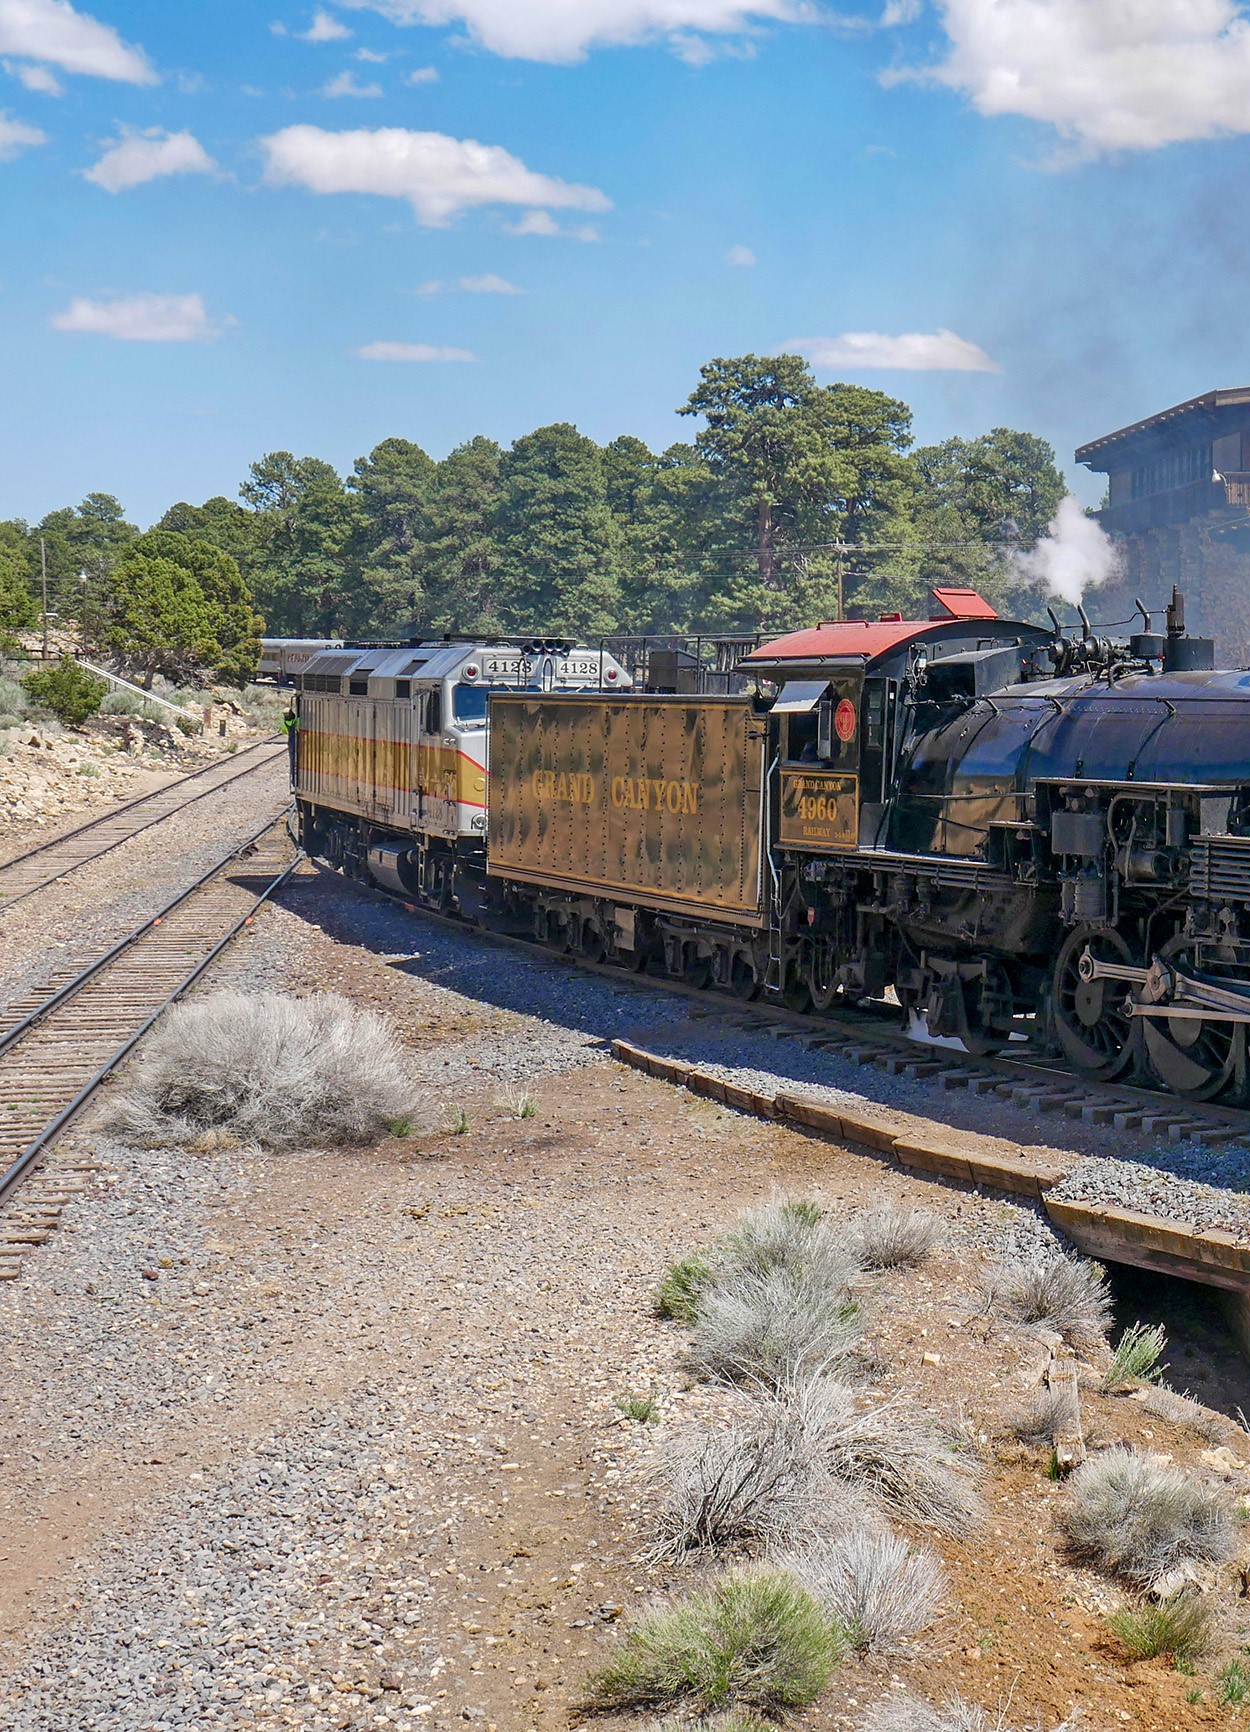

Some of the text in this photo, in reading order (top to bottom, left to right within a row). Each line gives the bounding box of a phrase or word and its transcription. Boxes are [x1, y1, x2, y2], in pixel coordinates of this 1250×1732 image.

[488, 660, 532, 673] 4128
[560, 662, 598, 674] 4128
[532, 769, 699, 815] GRAND CANYON
[793, 779, 842, 792] GRAND CANYON
[798, 796, 838, 822] 4960
[803, 826, 831, 837] RAILWAY
